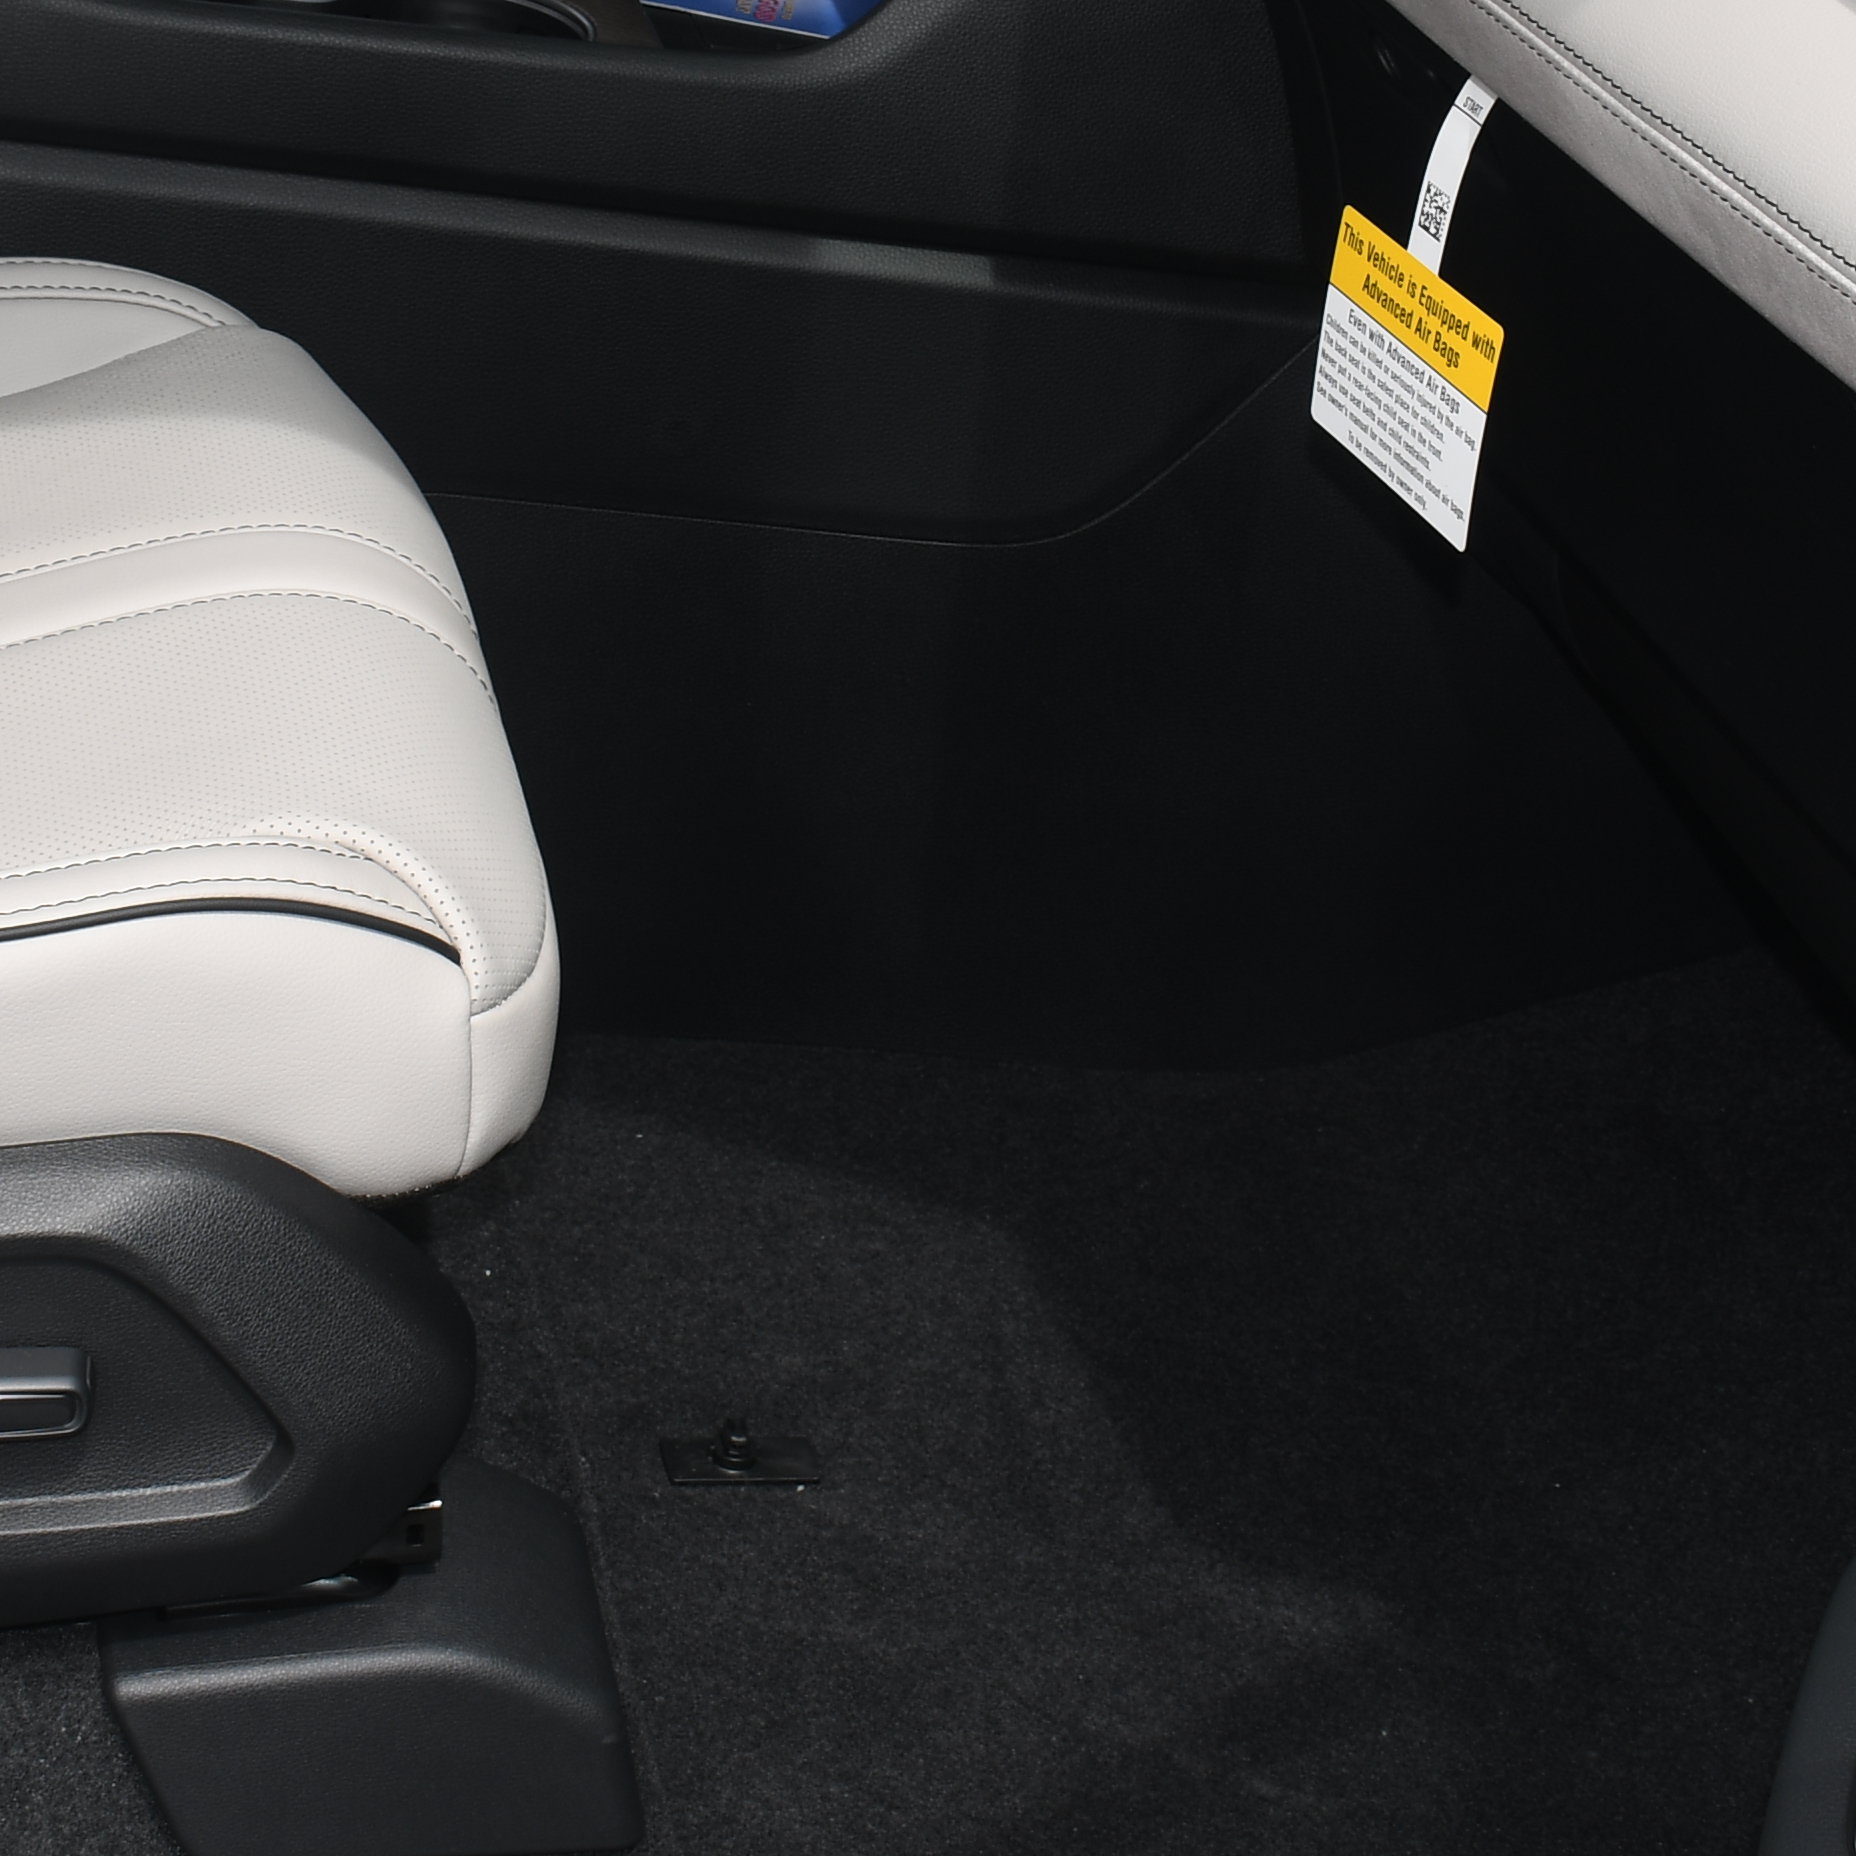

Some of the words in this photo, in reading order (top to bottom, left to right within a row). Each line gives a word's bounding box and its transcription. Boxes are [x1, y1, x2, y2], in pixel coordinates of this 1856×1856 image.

[1463, 97, 1484, 117] START
[1343, 222, 1363, 255] This
[1367, 240, 1404, 288] Vehicle
[1407, 274, 1418, 298] is
[1419, 285, 1470, 341] Equipped
[1472, 331, 1496, 363] with
[1362, 274, 1413, 328] Advanced
[1414, 317, 1431, 344] Air
[1433, 330, 1460, 368] Bags
[1319, 365, 1337, 389] Always
[1350, 393, 1361, 409] seat
[1362, 402, 1376, 422] belts
[1377, 417, 1387, 432] and
[1388, 427, 1402, 445] child
[1321, 348, 1337, 369] Never
[1338, 363, 1347, 377] put
[1353, 377, 1382, 411] rear-facing
[1383, 403, 1397, 421] child
[1398, 418, 1410, 433] seat
[1411, 427, 1416, 439] in
[1417, 431, 1426, 447] the
[1324, 331, 1333, 346] The
[1335, 339, 1347, 358] back
[1349, 353, 1360, 369] seat
[1361, 364, 1366, 375] is
[1367, 368, 1376, 383] the
[1395, 394, 1410, 413] place
[1411, 406, 1419, 419] for
[1326, 313, 1348, 340] Children
[1349, 335, 1359, 348] can
[1360, 343, 1366, 356] be
[1368, 347, 1382, 369] killed
[1383, 365, 1389, 374] or
[1391, 369, 1415, 398] seriously
[1416, 389, 1436, 415] injured
[1436, 407, 1444, 424] by
[1444, 415, 1454, 431] the
[1455, 426, 1463, 439] air
[1348, 308, 1366, 333] Even
[1369, 327, 1385, 349] with
[1386, 341, 1424, 384] Advanced
[1426, 375, 1438, 396] Air
[1440, 384, 1460, 414] Bags
[1317, 381, 1326, 397] See
[1328, 393, 1348, 417] owner's
[1349, 412, 1369, 435] manual
[1378, 435, 1392, 455] more
[1393, 450, 1424, 484] information
[1425, 479, 1441, 500] about
[1441, 493, 1449, 506] air
[1349, 430, 1354, 444] To
[1355, 435, 1362, 451] be
[1363, 446, 1387, 474] removed
[1388, 466, 1395, 482] by
[1396, 476, 1414, 496] owner
